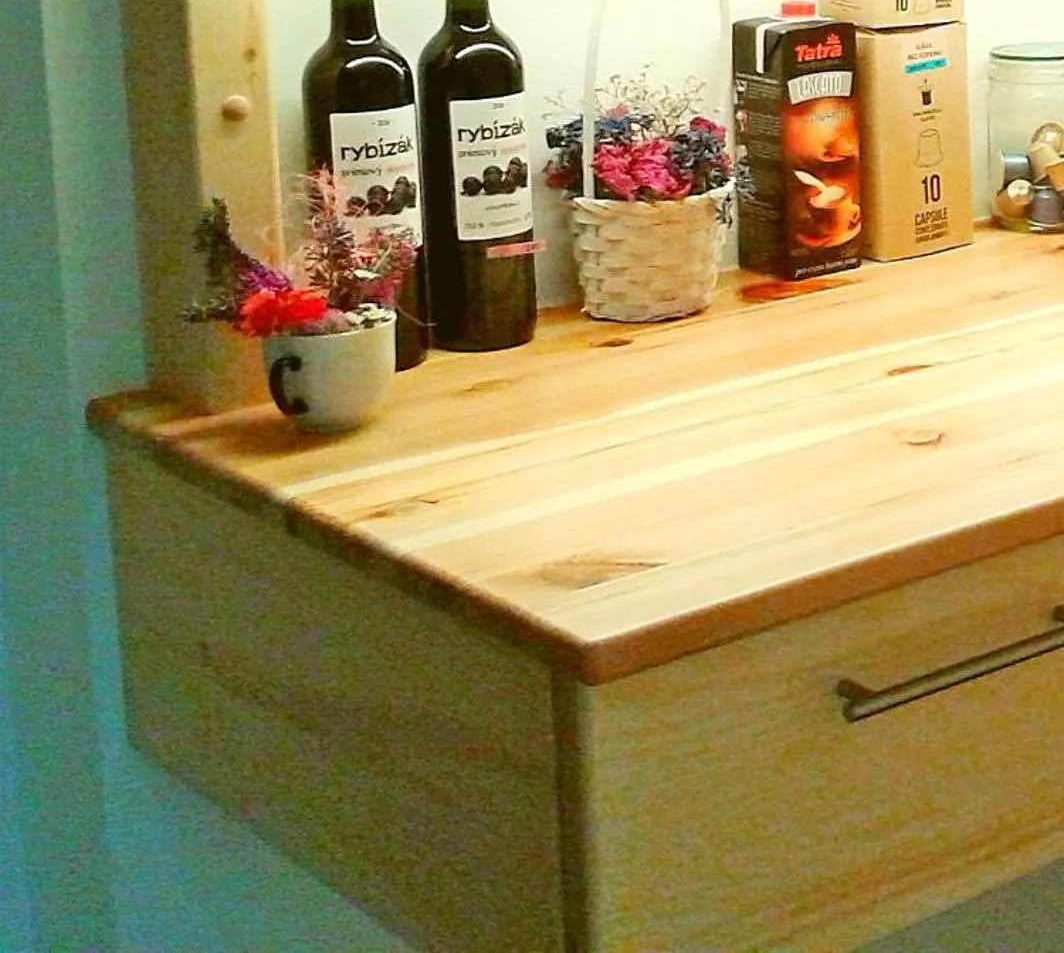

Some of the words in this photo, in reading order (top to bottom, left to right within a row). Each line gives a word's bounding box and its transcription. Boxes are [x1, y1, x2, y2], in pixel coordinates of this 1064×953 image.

[456, 117, 526, 143] rybízák
[340, 133, 414, 162] rybízák
[920, 173, 942, 205] 10
